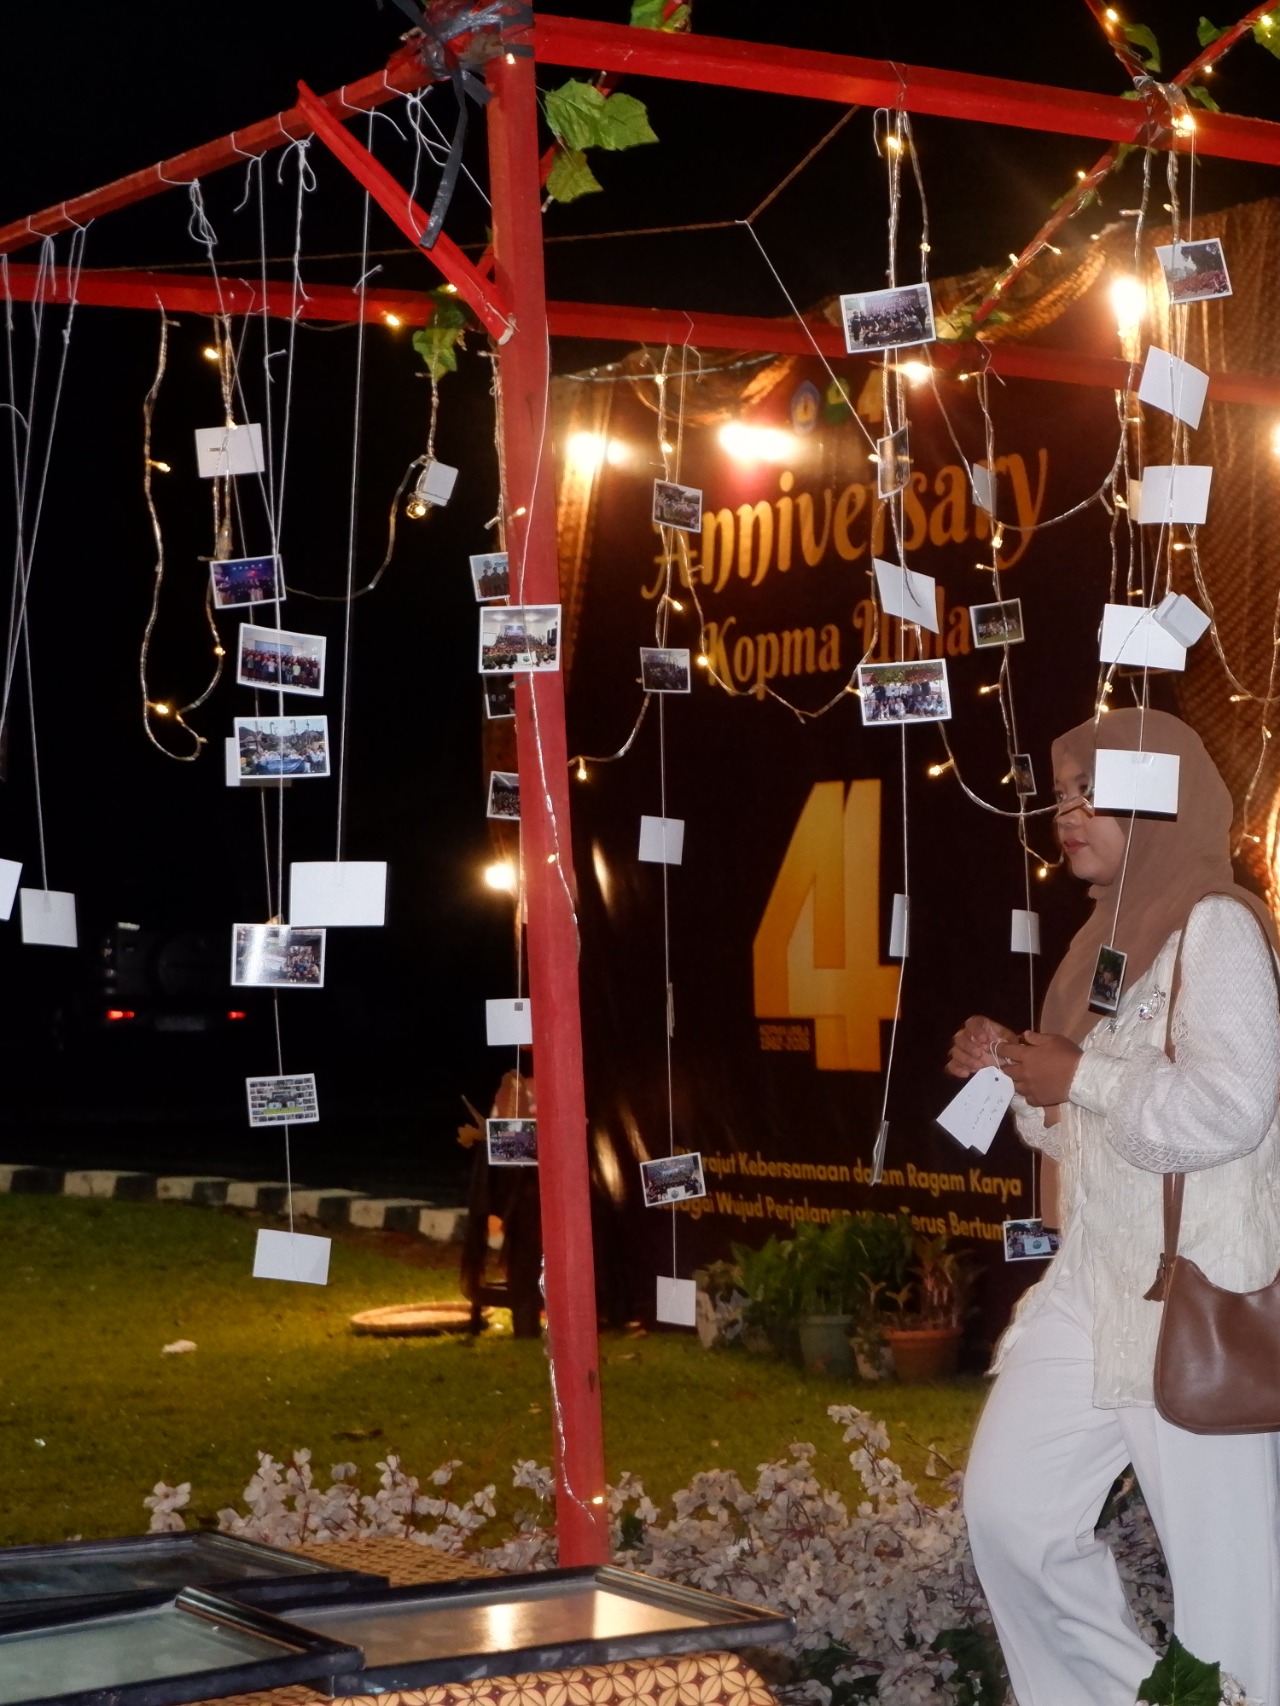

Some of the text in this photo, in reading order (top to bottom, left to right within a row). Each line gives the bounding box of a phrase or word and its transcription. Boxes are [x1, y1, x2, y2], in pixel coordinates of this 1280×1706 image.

[699, 615, 840, 701] Kopma
[738, 1150, 850, 1182] Kebersamaan
[906, 1162, 965, 1197] Ragam
[969, 1168, 1022, 1204] Karya
[716, 1191, 764, 1224] Wujud
[900, 1205, 947, 1235] erus
